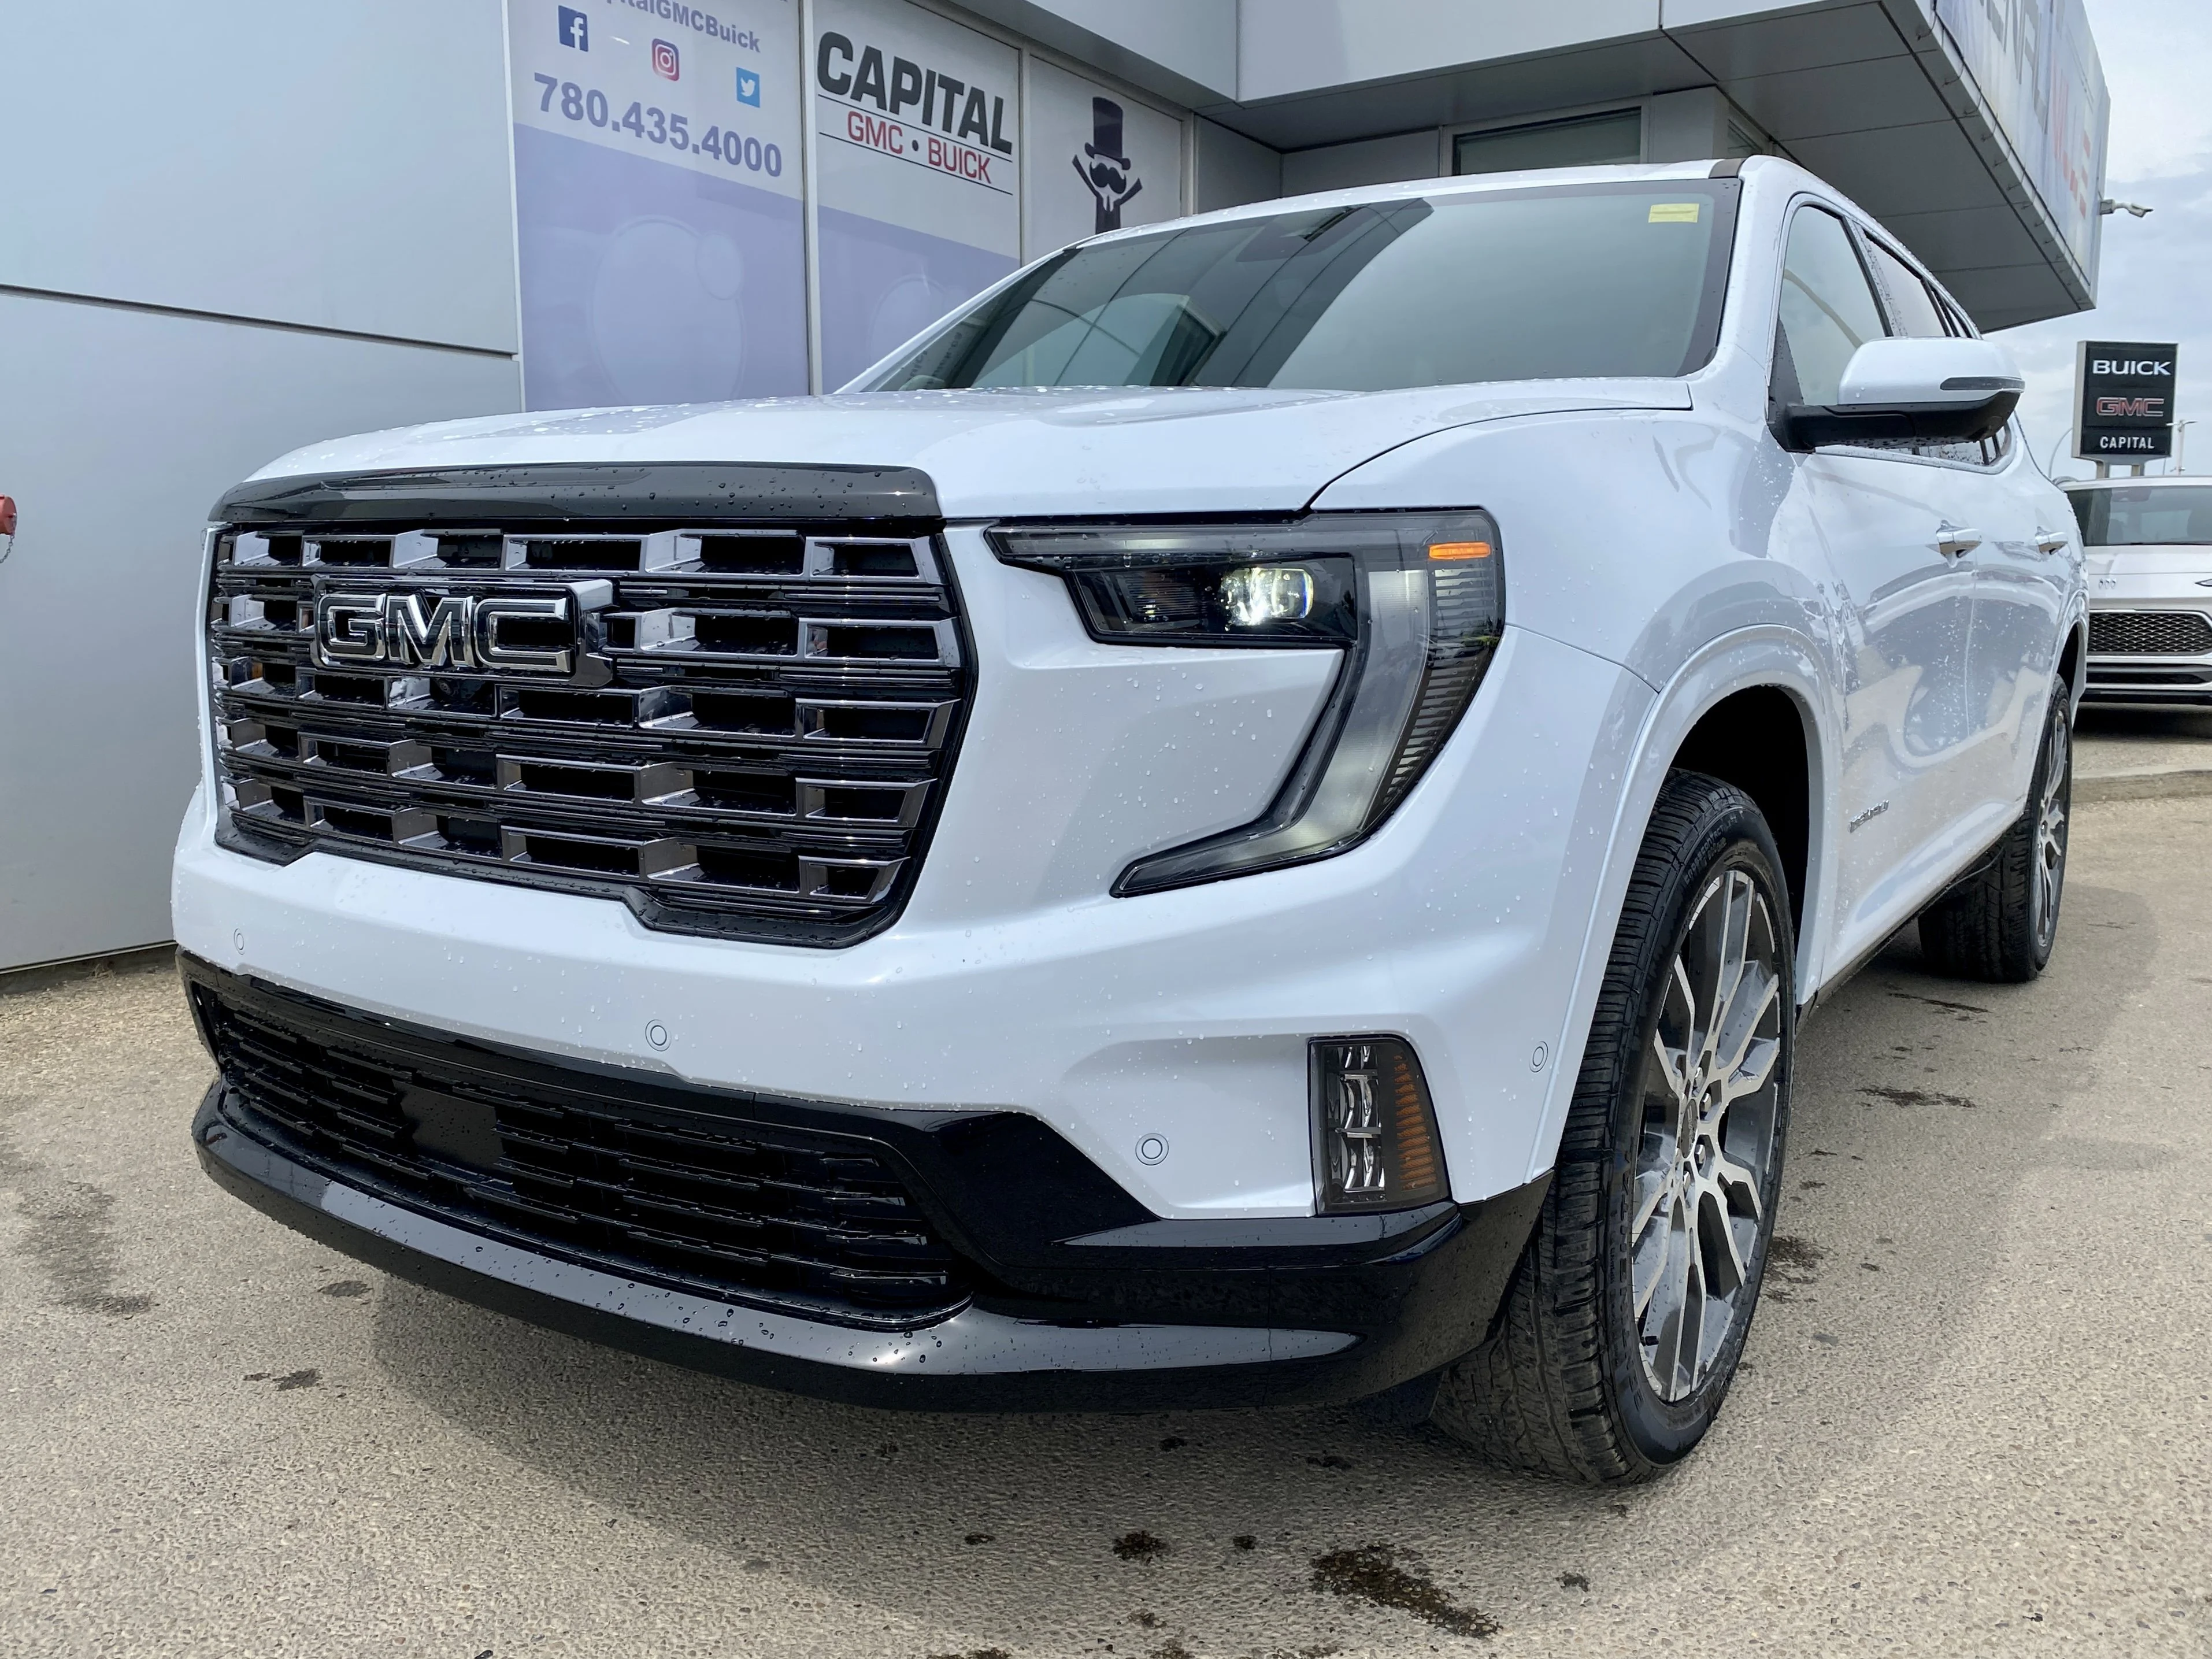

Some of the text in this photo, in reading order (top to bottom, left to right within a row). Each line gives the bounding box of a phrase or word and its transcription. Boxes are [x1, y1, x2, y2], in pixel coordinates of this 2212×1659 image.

[533, 72, 783, 177] 780.435.4000
[817, 31, 1013, 155] CAPITAL
[847, 110, 992, 184] GMC BUICK
[2092, 360, 2171, 375] BUICK
[2096, 397, 2164, 417] GMC
[2100, 436, 2155, 449] CAPITAL
[317, 592, 571, 673] GMC
